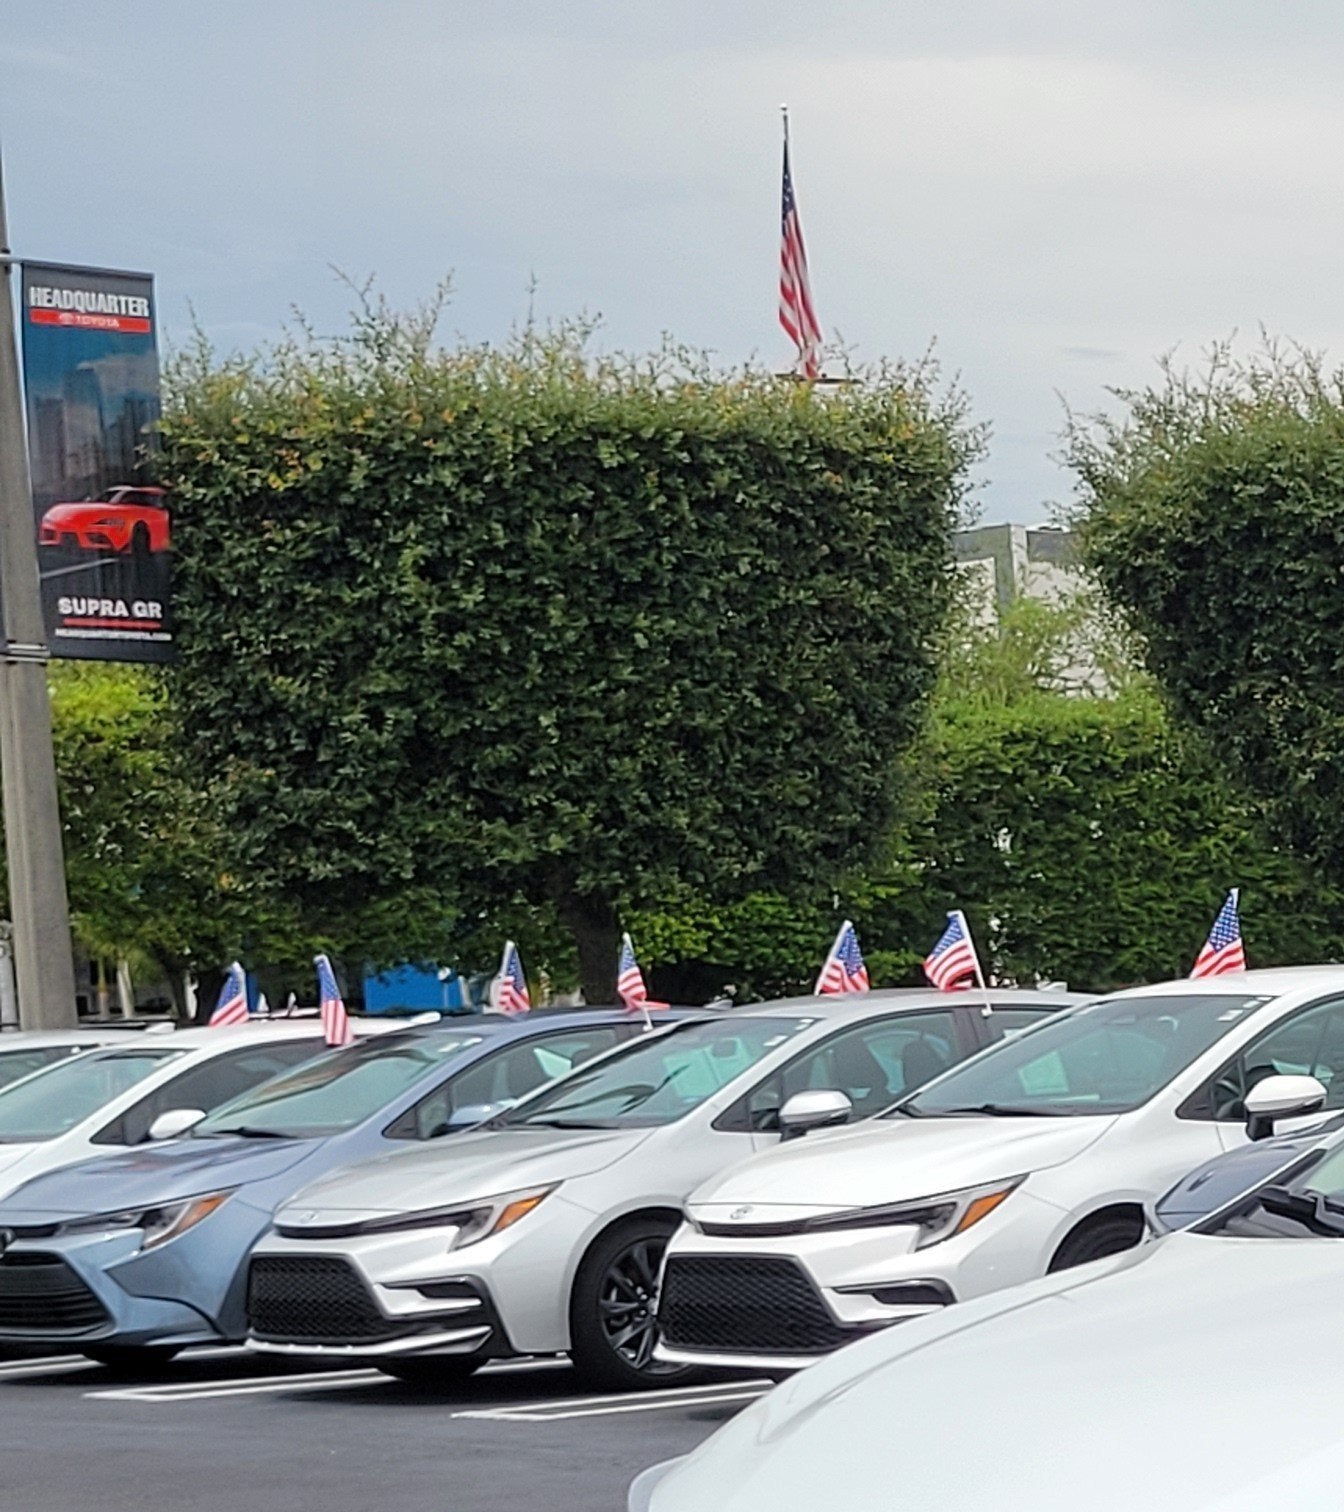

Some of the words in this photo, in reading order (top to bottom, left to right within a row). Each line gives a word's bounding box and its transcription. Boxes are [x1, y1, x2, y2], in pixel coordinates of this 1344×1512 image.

[29, 285, 150, 317] HEADQUARTER
[75, 314, 120, 328] TOYOTA
[58, 596, 130, 617] SUPRA
[132, 600, 163, 619] GR
